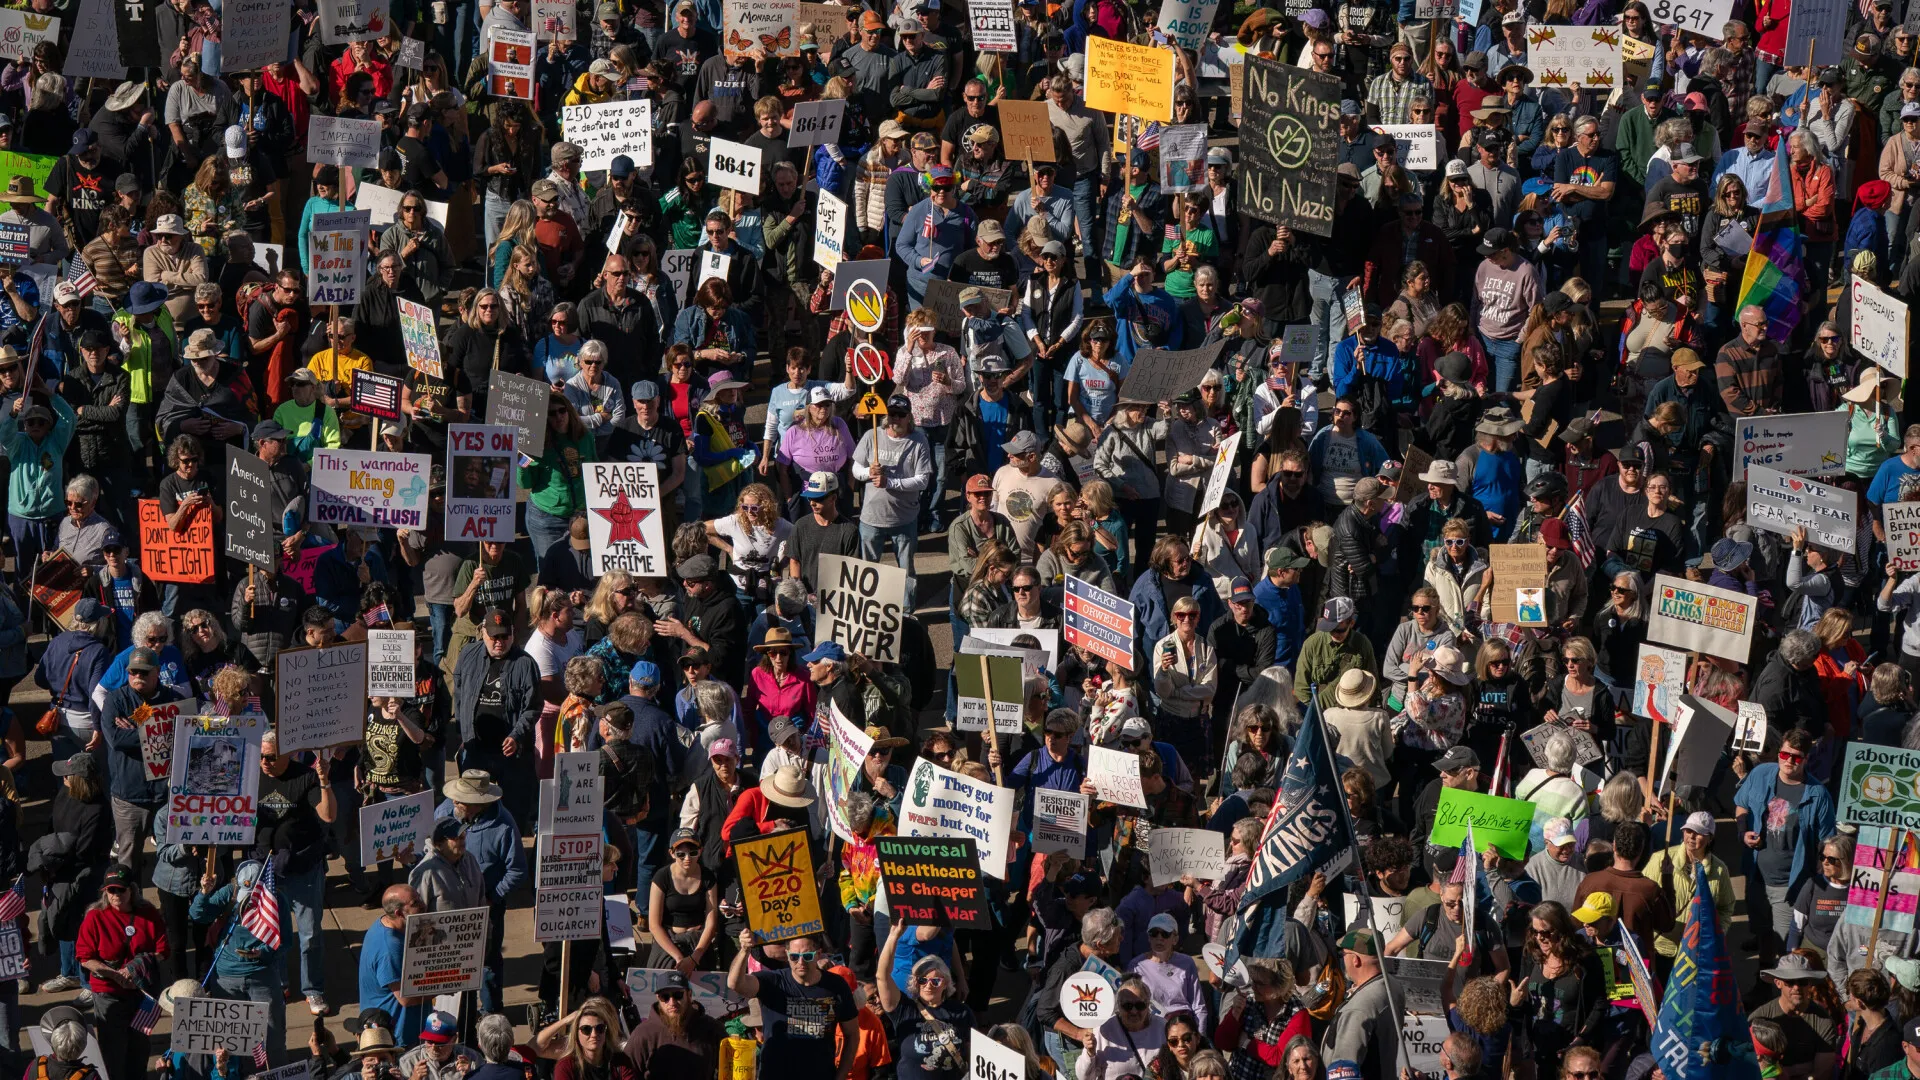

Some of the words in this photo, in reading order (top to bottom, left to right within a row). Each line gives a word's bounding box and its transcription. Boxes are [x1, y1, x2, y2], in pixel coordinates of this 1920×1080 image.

[235, 1, 272, 13] COMPLY
[337, 4, 362, 17] WHILE
[749, 2, 767, 10] ONLY
[974, 8, 1008, 18] HANDS
[1419, 8, 1432, 17] HB
[232, 13, 282, 26] MURDER
[537, 9, 568, 18] SINCE
[739, 12, 783, 24] MONARCH
[1188, 8, 1202, 19] IS
[1653, 0, 1714, 31] 8647
[976, 18, 1011, 31] OFF!
[1167, 19, 1207, 34] ABOVE
[230, 26, 278, 39] RACISM
[237, 38, 279, 50] FASCISM
[1141, 56, 1162, 65] FORCE
[1113, 82, 1136, 92] BADLY
[1248, 67, 1280, 105] No
[1285, 74, 1341, 129] Kings
[565, 108, 591, 121] 250
[599, 107, 623, 120] years
[629, 105, 646, 117] ago
[1007, 112, 1038, 123] DUMP
[315, 117, 337, 127] STOP
[796, 115, 837, 133] 8647
[321, 131, 371, 144] IMPEACH
[600, 132, 617, 141] We
[622, 128, 648, 139] won't
[1008, 134, 1045, 148] TRUMP
[1405, 130, 1432, 138] KINGS
[312, 147, 335, 159] Trump
[611, 143, 647, 154] another!
[715, 154, 755, 177] 8647
[81, 189, 97, 200] NO
[1244, 173, 1273, 212] No
[1281, 179, 1333, 222] Nazis
[818, 202, 837, 221] Just
[317, 217, 342, 226] Planet
[344, 216, 368, 226] Trump
[816, 228, 841, 254] VIAGRA
[415, 384, 447, 395] RESIST
[509, 380, 526, 393] power
[1085, 379, 1105, 388] NASTY
[502, 392, 519, 403] people
[495, 406, 525, 422] STRONGER
[450, 431, 484, 451] YES
[491, 434, 513, 451] ON
[318, 454, 348, 471] This
[361, 458, 419, 473] wannabe
[814, 454, 839, 464] TRUMP
[231, 458, 264, 488] America
[595, 466, 648, 484] RAGE
[349, 471, 395, 498] King
[316, 491, 376, 506] Deserves
[600, 484, 654, 501] AGAINST
[1753, 484, 1801, 504] trumps
[1812, 504, 1850, 522] FEAR
[231, 501, 265, 533] Country
[317, 504, 366, 523] ROYAL
[373, 507, 420, 526] FLUSH
[447, 505, 481, 516] VOTING
[484, 505, 511, 515] RIGHTS
[462, 518, 497, 537] ACT
[1817, 530, 1853, 548] TRUMP
[227, 534, 270, 565] Immigrants
[614, 543, 639, 555] THE
[145, 548, 168, 569] THE
[170, 547, 211, 576] FIGHT
[602, 555, 654, 573] REGIME
[839, 562, 878, 597] NO
[1088, 589, 1117, 609] MAKE
[1675, 590, 1693, 602] NO
[820, 590, 900, 633] KINGS
[1661, 598, 1702, 619] KINGS
[1706, 606, 1745, 622] IDIOTS
[1082, 606, 1121, 630] ORWELL
[1082, 622, 1121, 645] FICTION
[382, 643, 402, 651] EYES
[834, 620, 894, 662] EVER
[1086, 639, 1117, 660] AGAIN
[285, 656, 308, 672] NO
[317, 647, 361, 667] KING
[383, 654, 402, 662] YOU
[372, 671, 413, 682] GOVERNED
[992, 703, 1018, 712] VALUES
[194, 727, 239, 736] AMERICA
[1040, 796, 1080, 808] RESISTING
[1102, 789, 1139, 805] FACISM
[173, 796, 255, 813] SCHOOL
[399, 804, 420, 819] Kings
[932, 798, 975, 820] money
[1045, 803, 1076, 816] KINGS
[554, 815, 594, 823] IMMIGRANTS
[908, 812, 937, 827] wars
[1439, 802, 1457, 826] 86
[389, 820, 410, 833] Wars
[218, 831, 242, 841] TIME
[386, 831, 416, 847] Empires
[1063, 835, 1079, 844] 1776
[1266, 800, 1338, 880] KINGS
[559, 841, 593, 854] STOP
[880, 842, 967, 858] Universal
[1151, 846, 1194, 862] WRONG
[1201, 847, 1222, 858] ICE
[540, 860, 589, 872] DEPORTATION
[884, 861, 976, 879] Healthcare
[1174, 859, 1224, 873] MELTING
[540, 875, 587, 885] KIDNAPPING
[757, 876, 802, 899] 220
[911, 882, 977, 902] Cheaper
[539, 891, 601, 903] DEMOCRACY
[762, 895, 800, 914] Days
[438, 914, 465, 924] COME
[945, 905, 979, 921] War
[449, 921, 483, 932] PEOPLE
[540, 920, 597, 932] OLIGARCHY
[753, 920, 822, 941] Midterms
[456, 932, 481, 941] NOW
[427, 950, 461, 958] BROTHER
[413, 957, 457, 966] EVERYBODY
[189, 1001, 254, 1019] FIRST
[1079, 1002, 1097, 1011] NO
[177, 1019, 261, 1035] AMENDMENT
[188, 1034, 252, 1052] FIRST
[1404, 1031, 1424, 1042] NO
